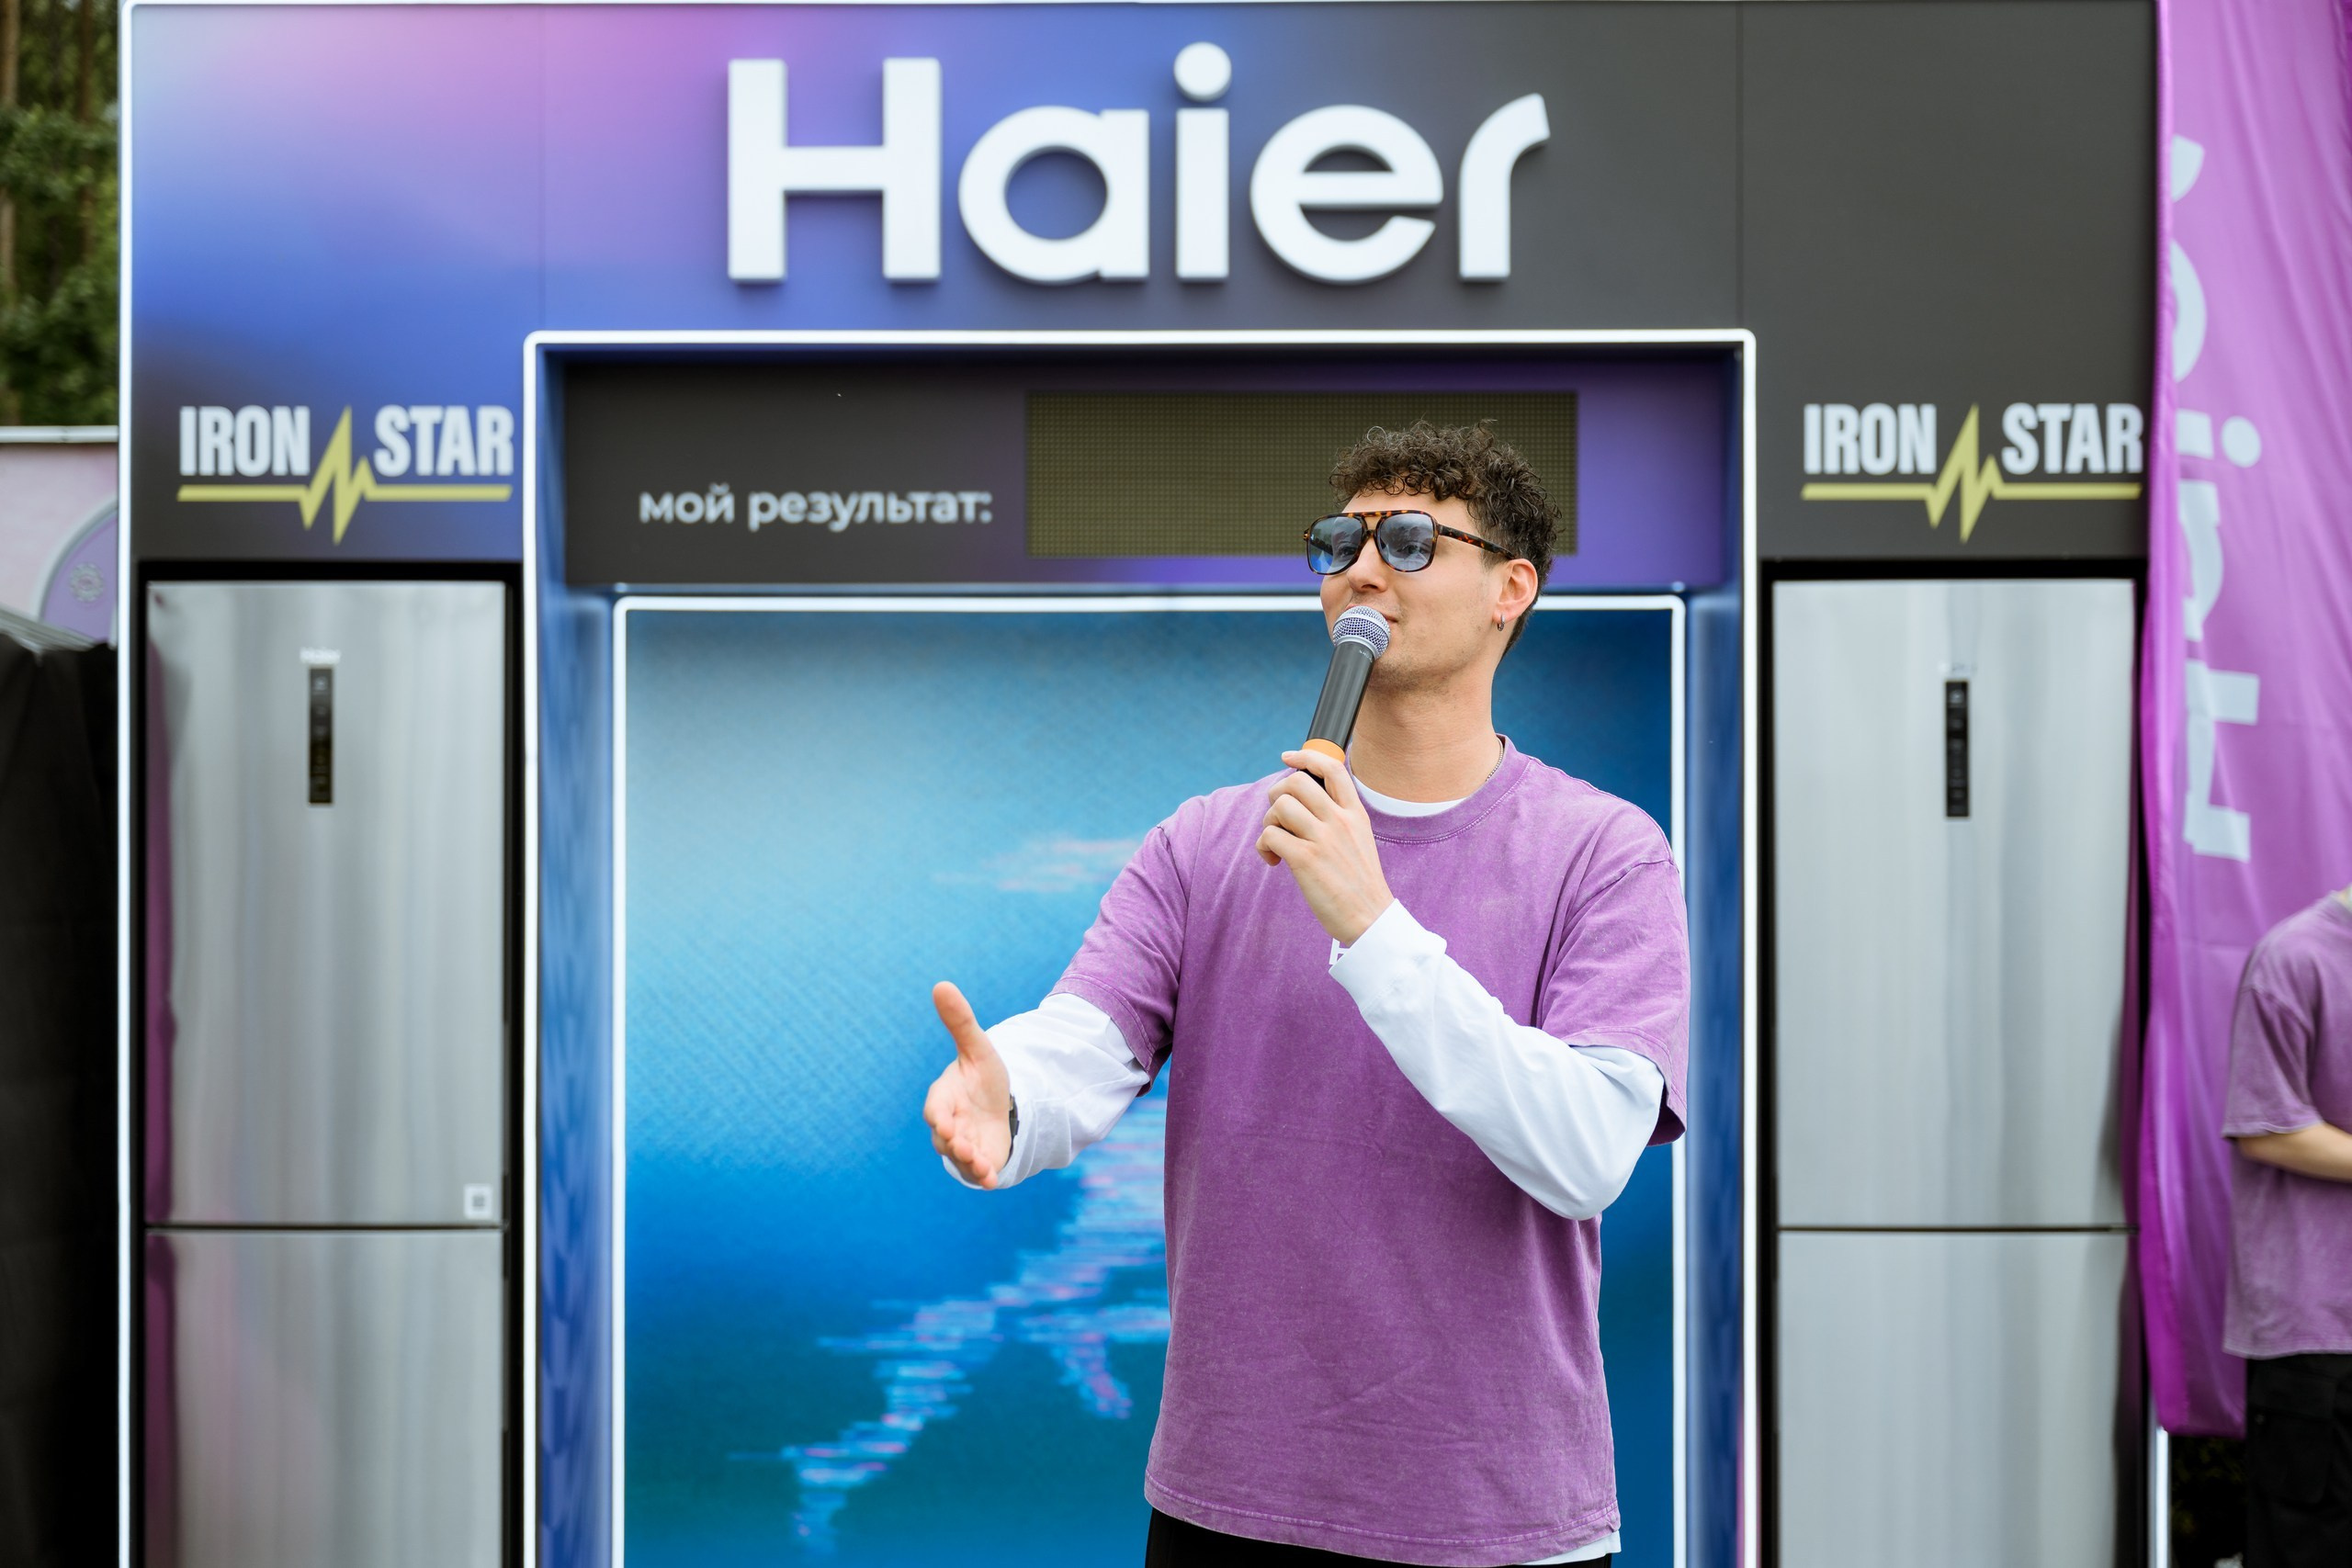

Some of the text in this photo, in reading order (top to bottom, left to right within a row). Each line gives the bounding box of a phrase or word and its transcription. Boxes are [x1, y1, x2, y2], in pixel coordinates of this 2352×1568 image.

[727, 42, 1552, 286] Haier
[179, 405, 514, 478] IRON STAR
[1804, 402, 2143, 475] IRON STAR
[639, 482, 994, 533] мой результат:
